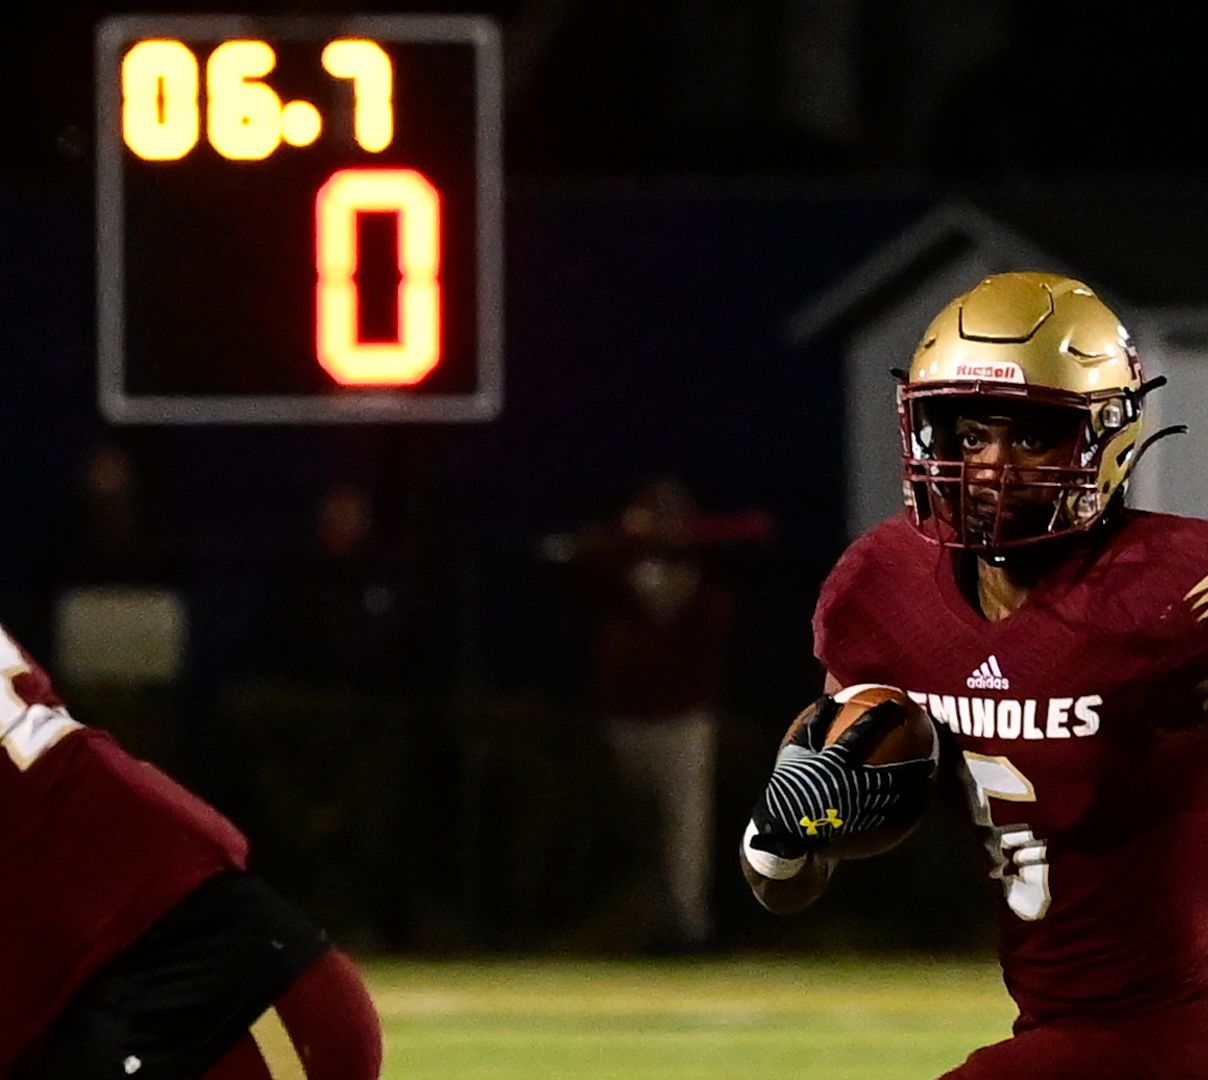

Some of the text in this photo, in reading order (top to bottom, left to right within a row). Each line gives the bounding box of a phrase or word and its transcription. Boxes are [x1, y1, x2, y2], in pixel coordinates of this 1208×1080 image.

[120, 38, 394, 162] 06.7
[315, 168, 442, 388] 0
[966, 674, 1010, 691] adidas
